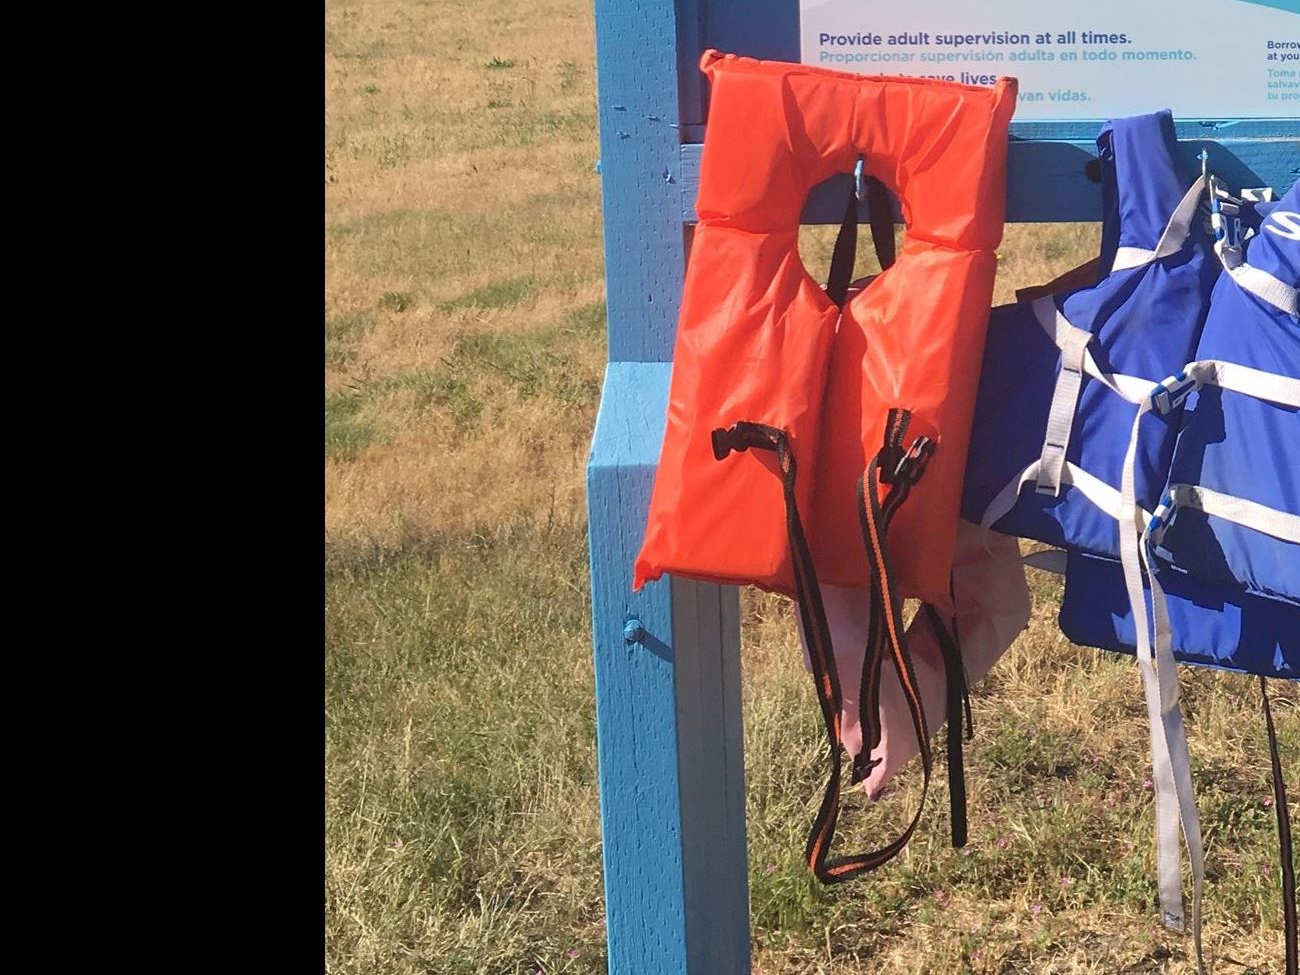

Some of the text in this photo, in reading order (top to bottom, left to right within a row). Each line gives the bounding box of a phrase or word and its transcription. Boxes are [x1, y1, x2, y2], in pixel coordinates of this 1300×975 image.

[820, 31, 1131, 47] Provide adult supervision at all times.
[820, 49, 1196, 64] Proporcionar supervisión adulta en todo momento.
[1019, 90, 1091, 102] van vidas.
